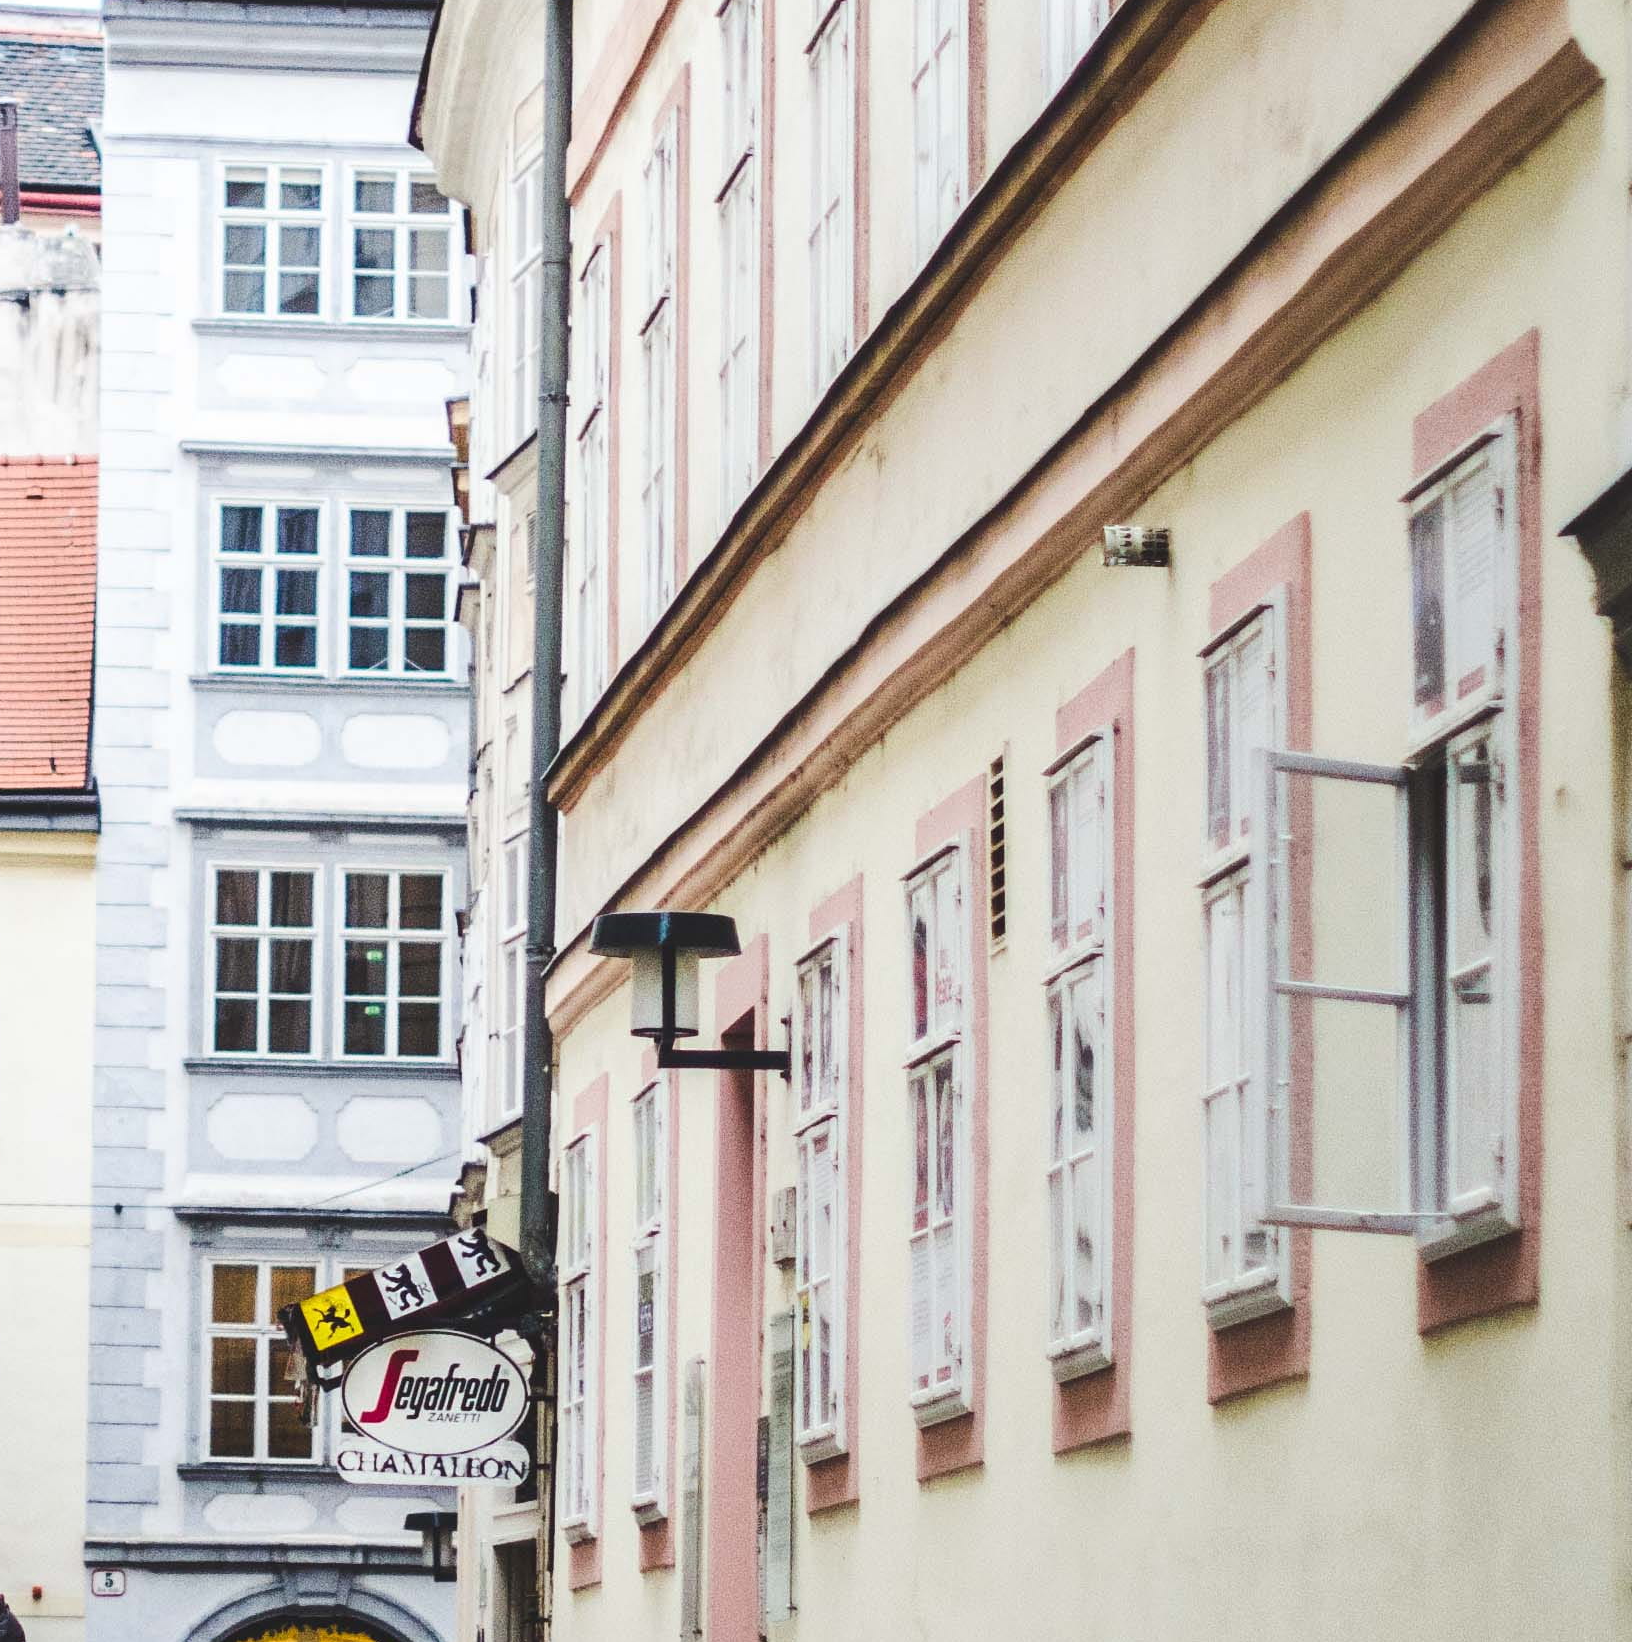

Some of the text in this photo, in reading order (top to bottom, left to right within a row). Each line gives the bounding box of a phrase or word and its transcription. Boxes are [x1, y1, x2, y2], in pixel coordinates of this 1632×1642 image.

[359, 1349, 510, 1423] Segafredo
[427, 1412, 481, 1423] ZANETTI
[104, 1572, 114, 1588] 5
